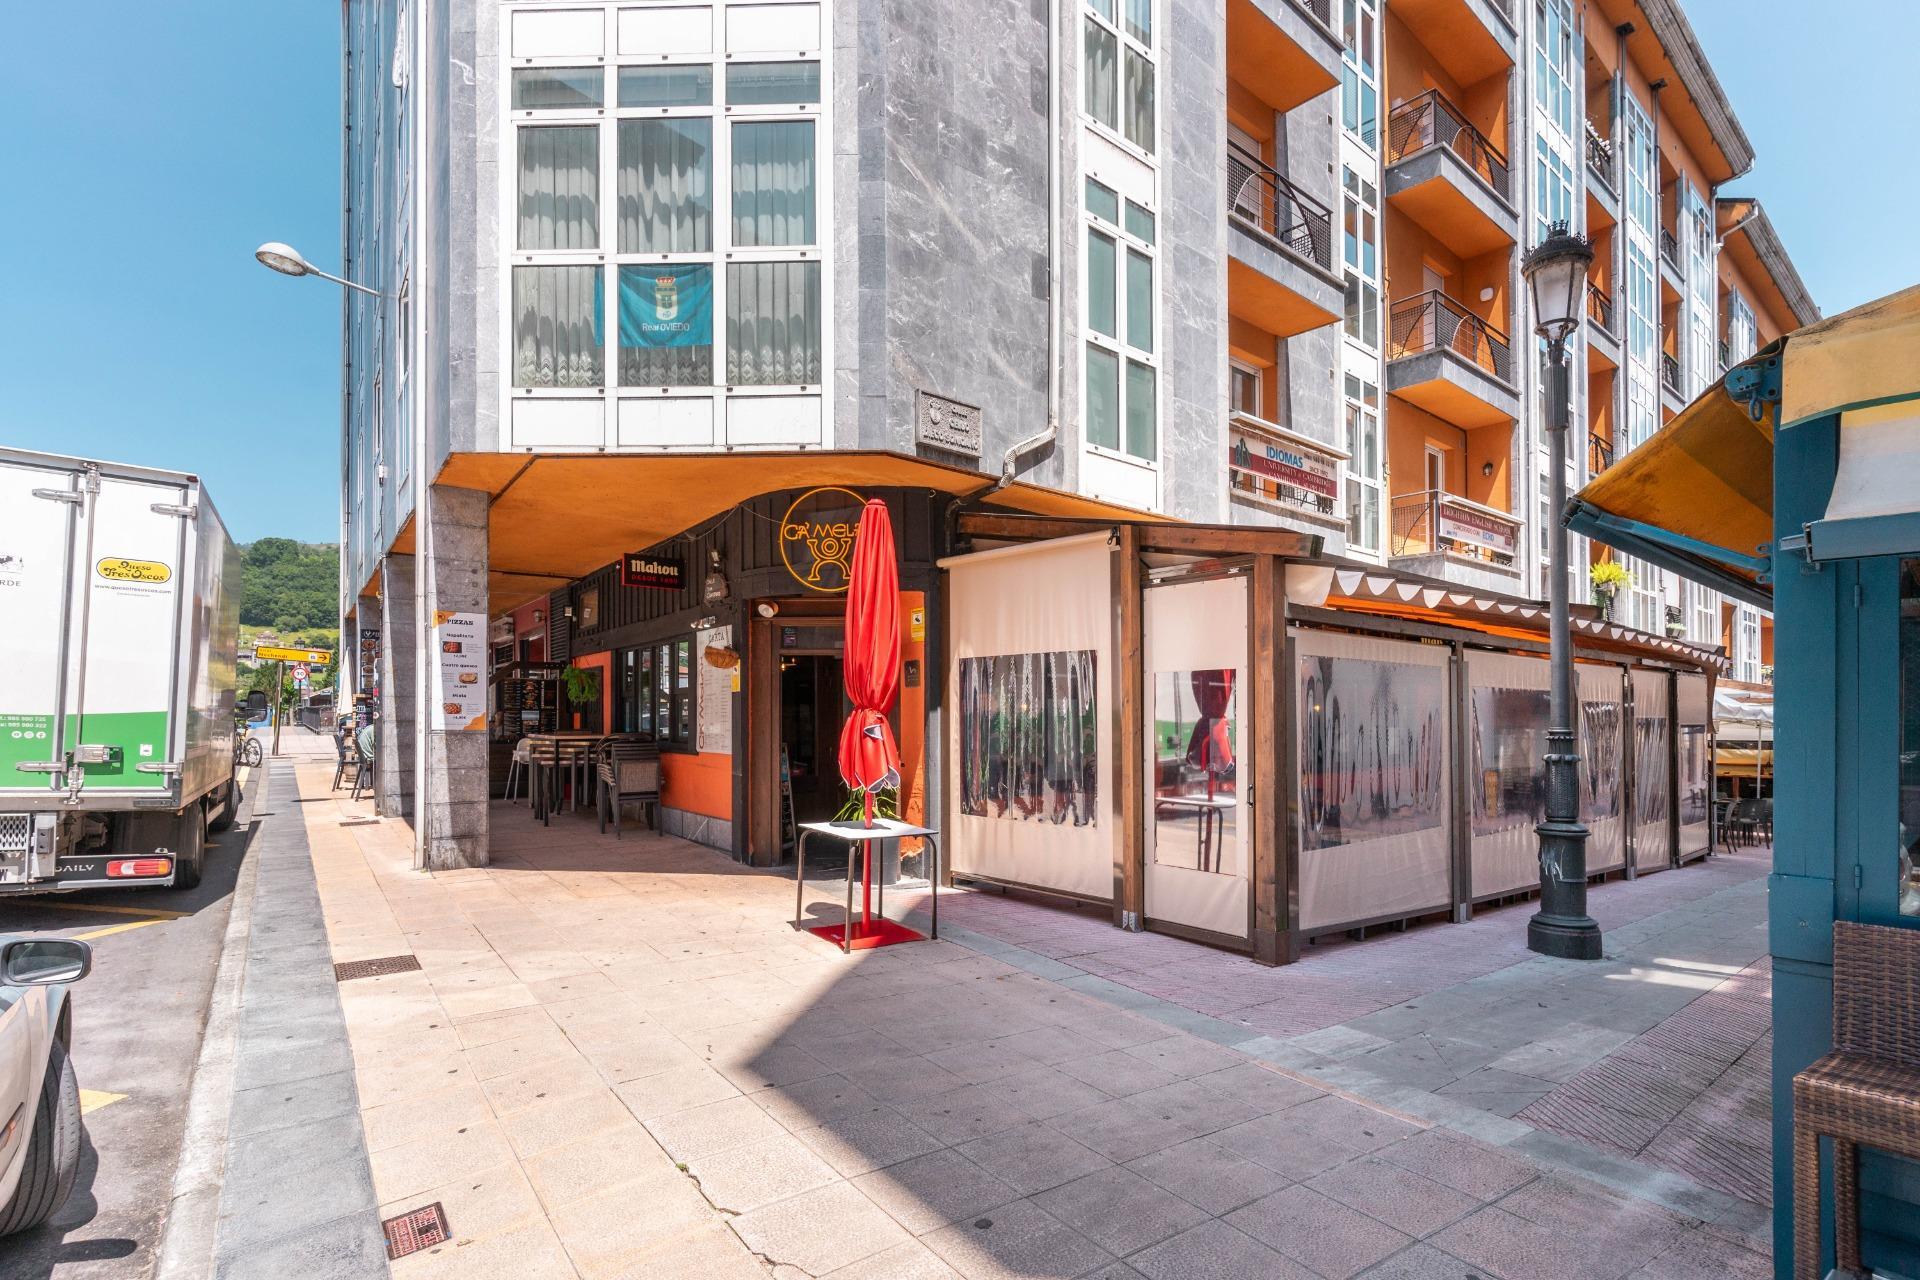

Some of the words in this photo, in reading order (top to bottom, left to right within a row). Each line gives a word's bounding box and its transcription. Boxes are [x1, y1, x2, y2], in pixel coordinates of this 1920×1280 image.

[660, 323, 690, 332] OVIEDO
[1266, 445, 1303, 469] IDIOMAS
[1471, 515, 1492, 529] ENGLISH
[118, 561, 152, 571] Queso
[631, 559, 678, 576] Mahou
[103, 567, 130, 577] Tres
[130, 569, 165, 581] Oscos
